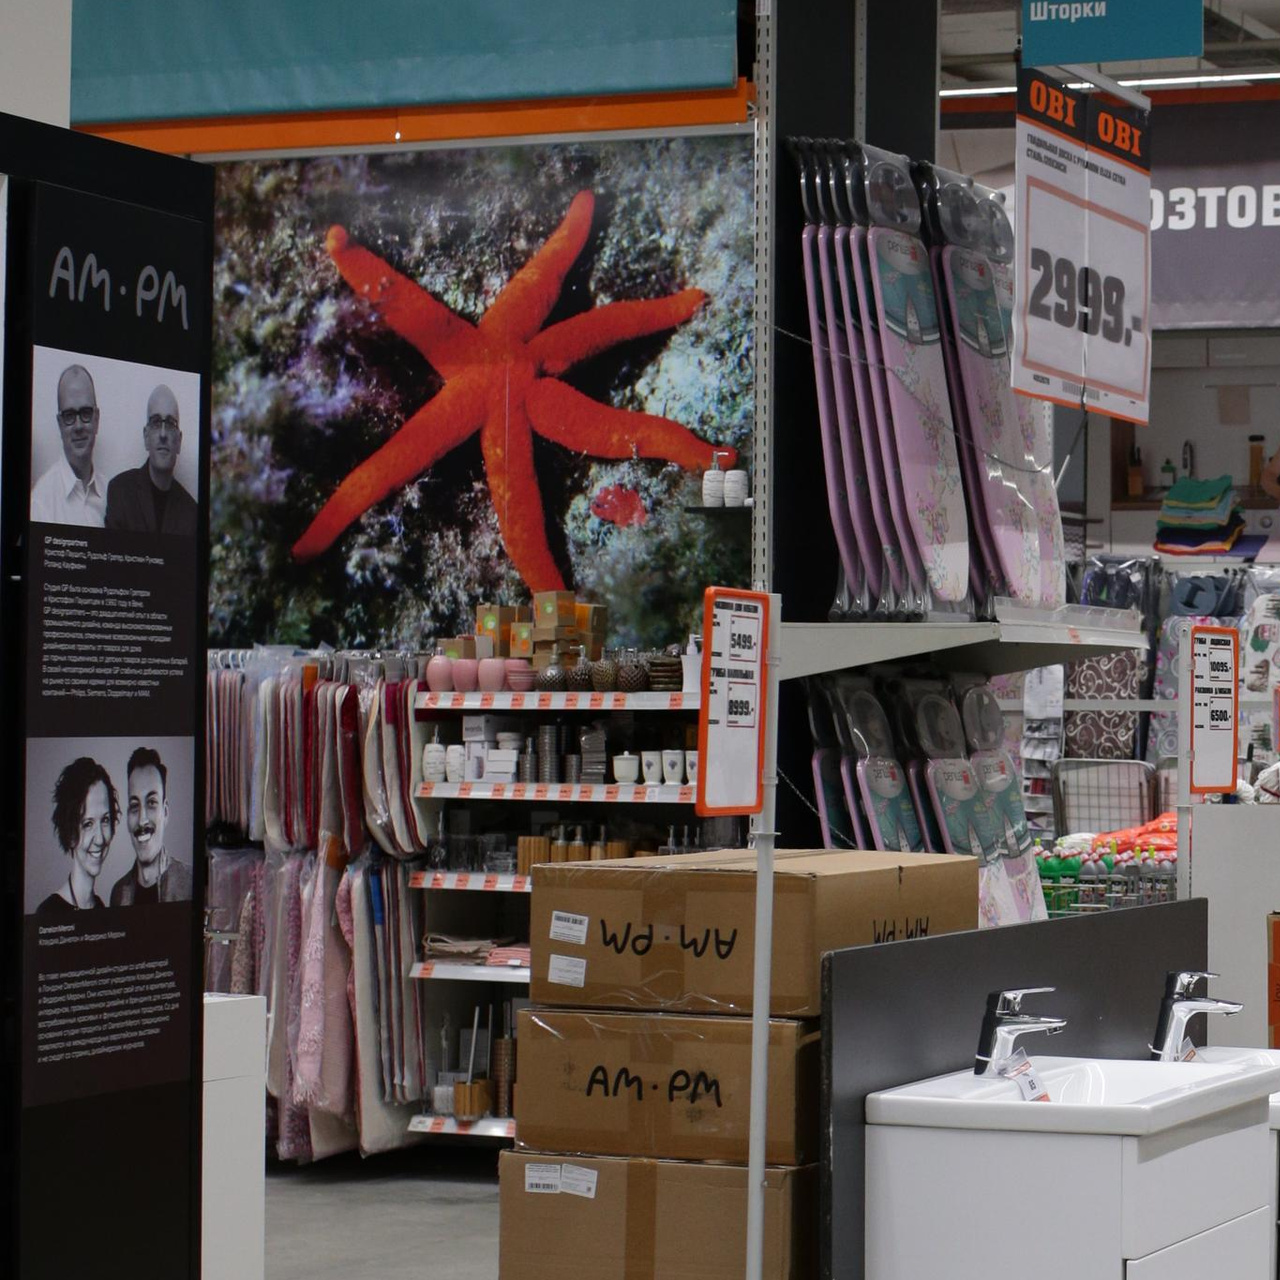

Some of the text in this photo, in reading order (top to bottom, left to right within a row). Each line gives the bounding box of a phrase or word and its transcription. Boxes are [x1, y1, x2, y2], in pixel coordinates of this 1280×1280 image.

[1030, 1, 1107, 23] Шторки
[1030, 78, 1077, 129] OBI
[1097, 111, 1142, 158] OBI
